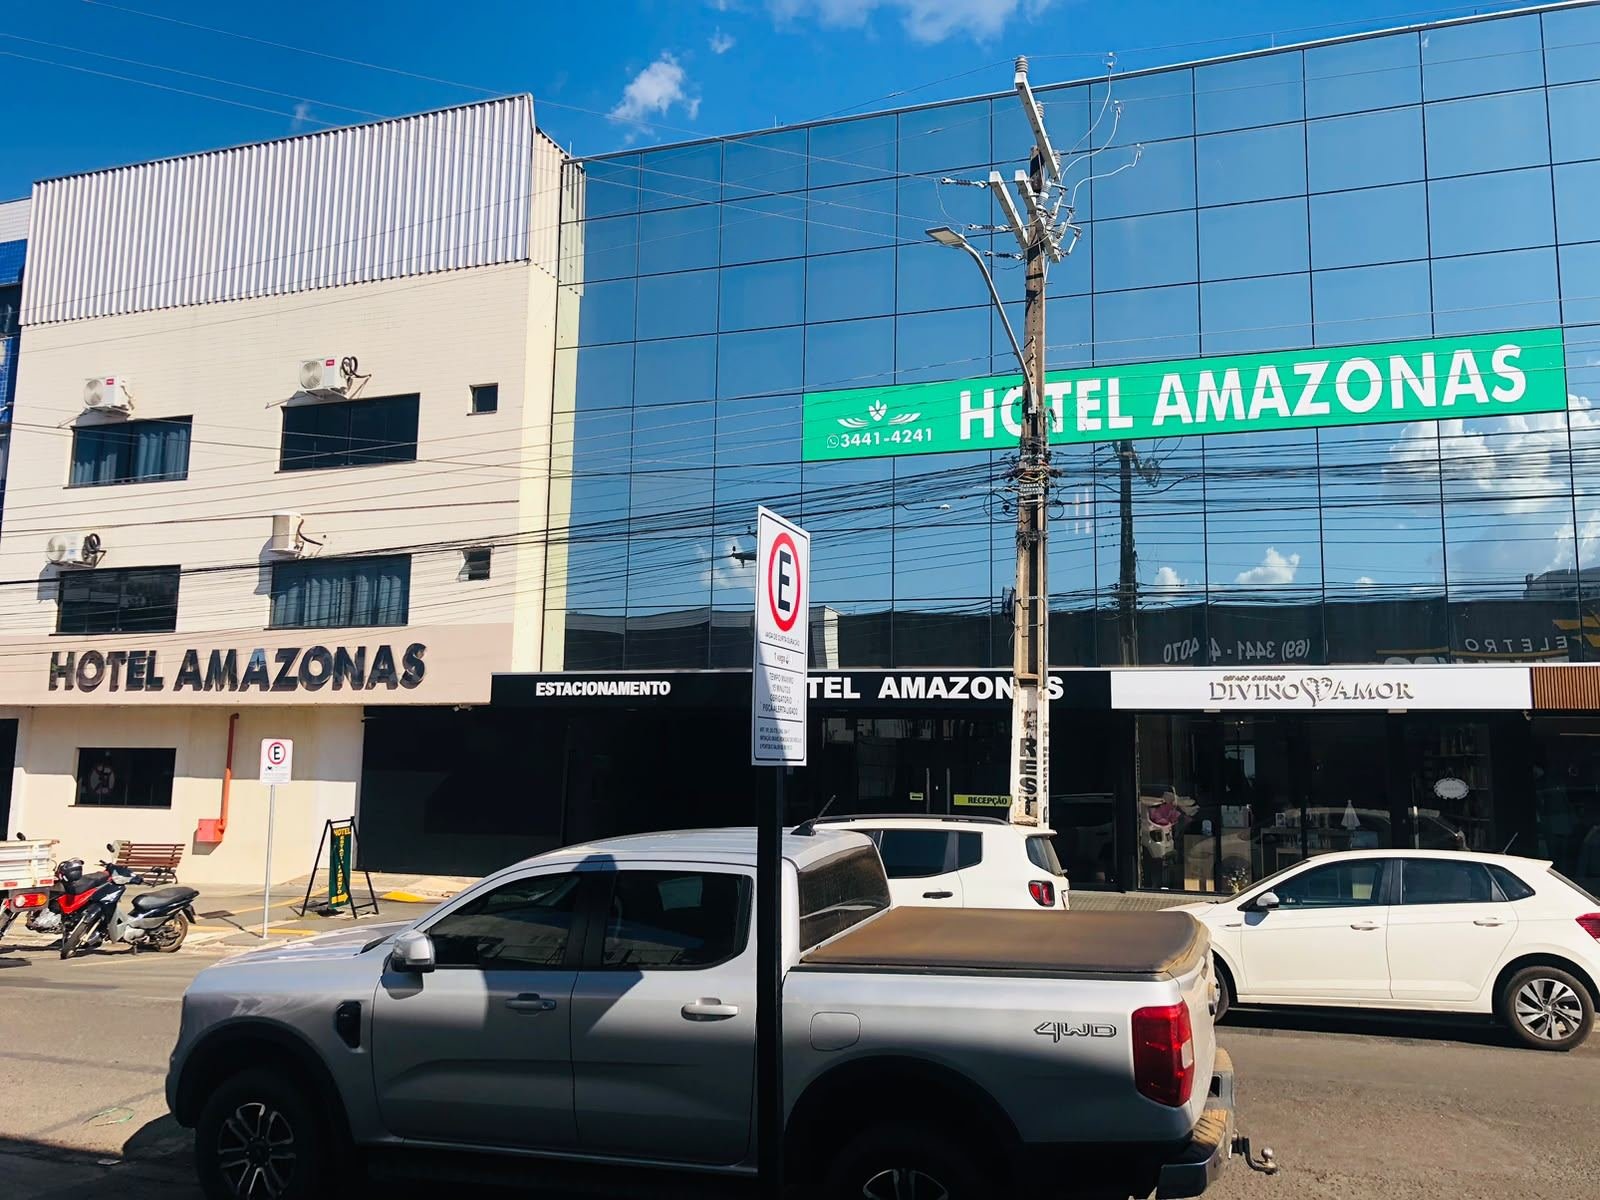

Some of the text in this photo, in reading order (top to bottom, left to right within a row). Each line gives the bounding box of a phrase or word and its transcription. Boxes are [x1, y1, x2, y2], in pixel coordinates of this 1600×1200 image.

[1151, 345, 1528, 427] AMAZONAS
[840, 427, 932, 448] 3441-4241
[778, 550, 791, 612] E
[48, 642, 427, 692] HOTEL AMAZONAS
[535, 681, 671, 696] ESTACIONAMENTO
[807, 676, 1064, 700] TEL AMAZONS
[1209, 681, 1414, 700] DIVINO AMOR
[273, 746, 280, 760] E
[967, 796, 1008, 806] RECEPÇÃO
[1033, 1022, 1117, 1043] 4WD
